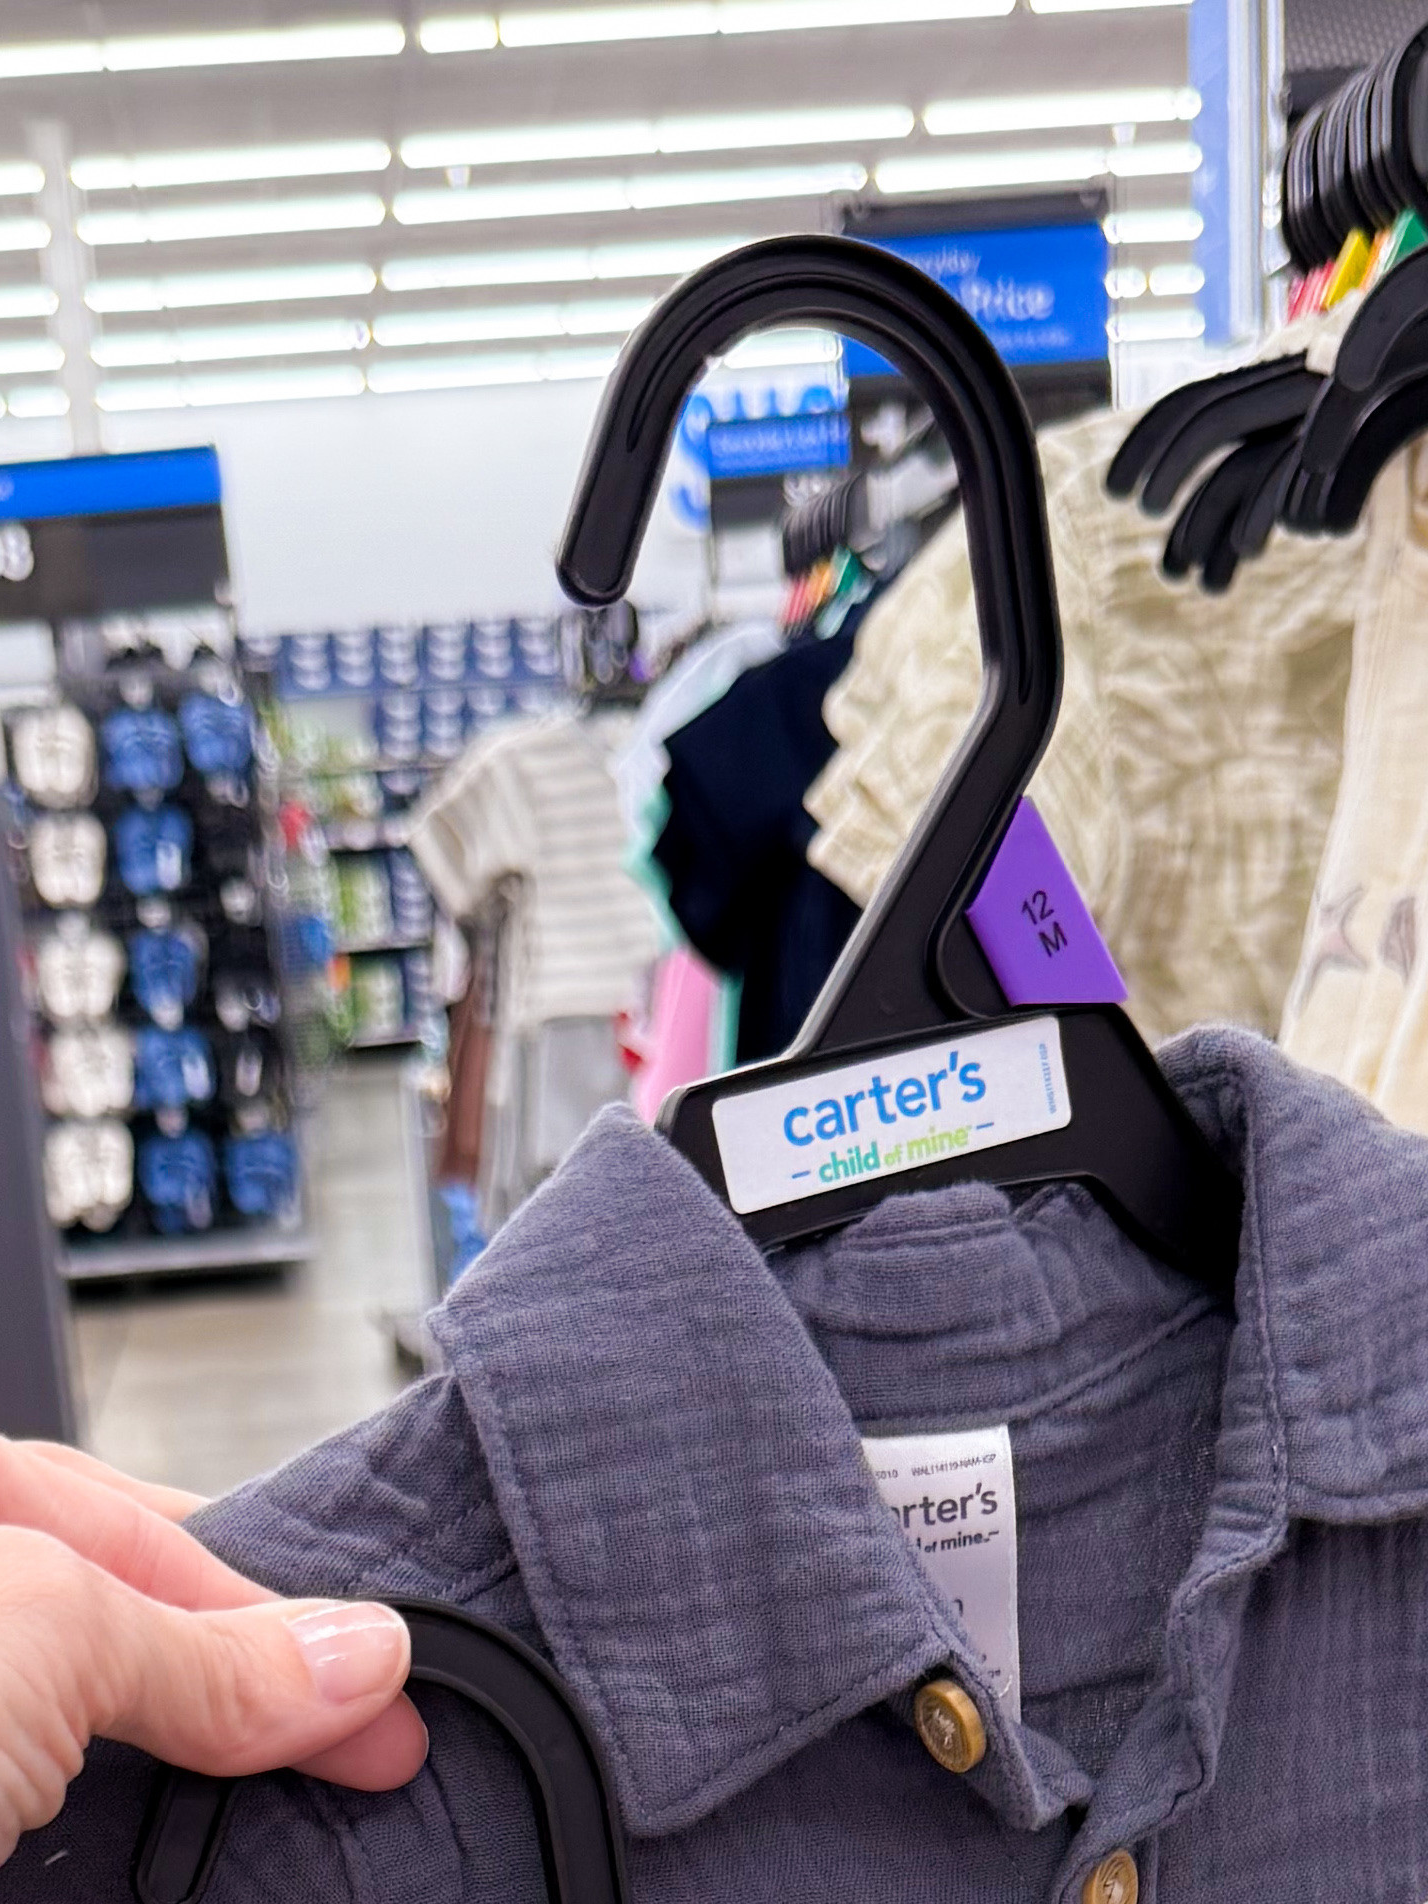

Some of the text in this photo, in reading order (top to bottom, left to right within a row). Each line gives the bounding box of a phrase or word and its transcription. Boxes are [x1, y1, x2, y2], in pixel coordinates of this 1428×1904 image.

[1021, 890, 1055, 926] 12
[1039, 922, 1069, 958] M
[783, 1050, 987, 1147] carter's
[818, 1126, 971, 1183] child of mine
[890, 1481, 999, 1529] rter's
